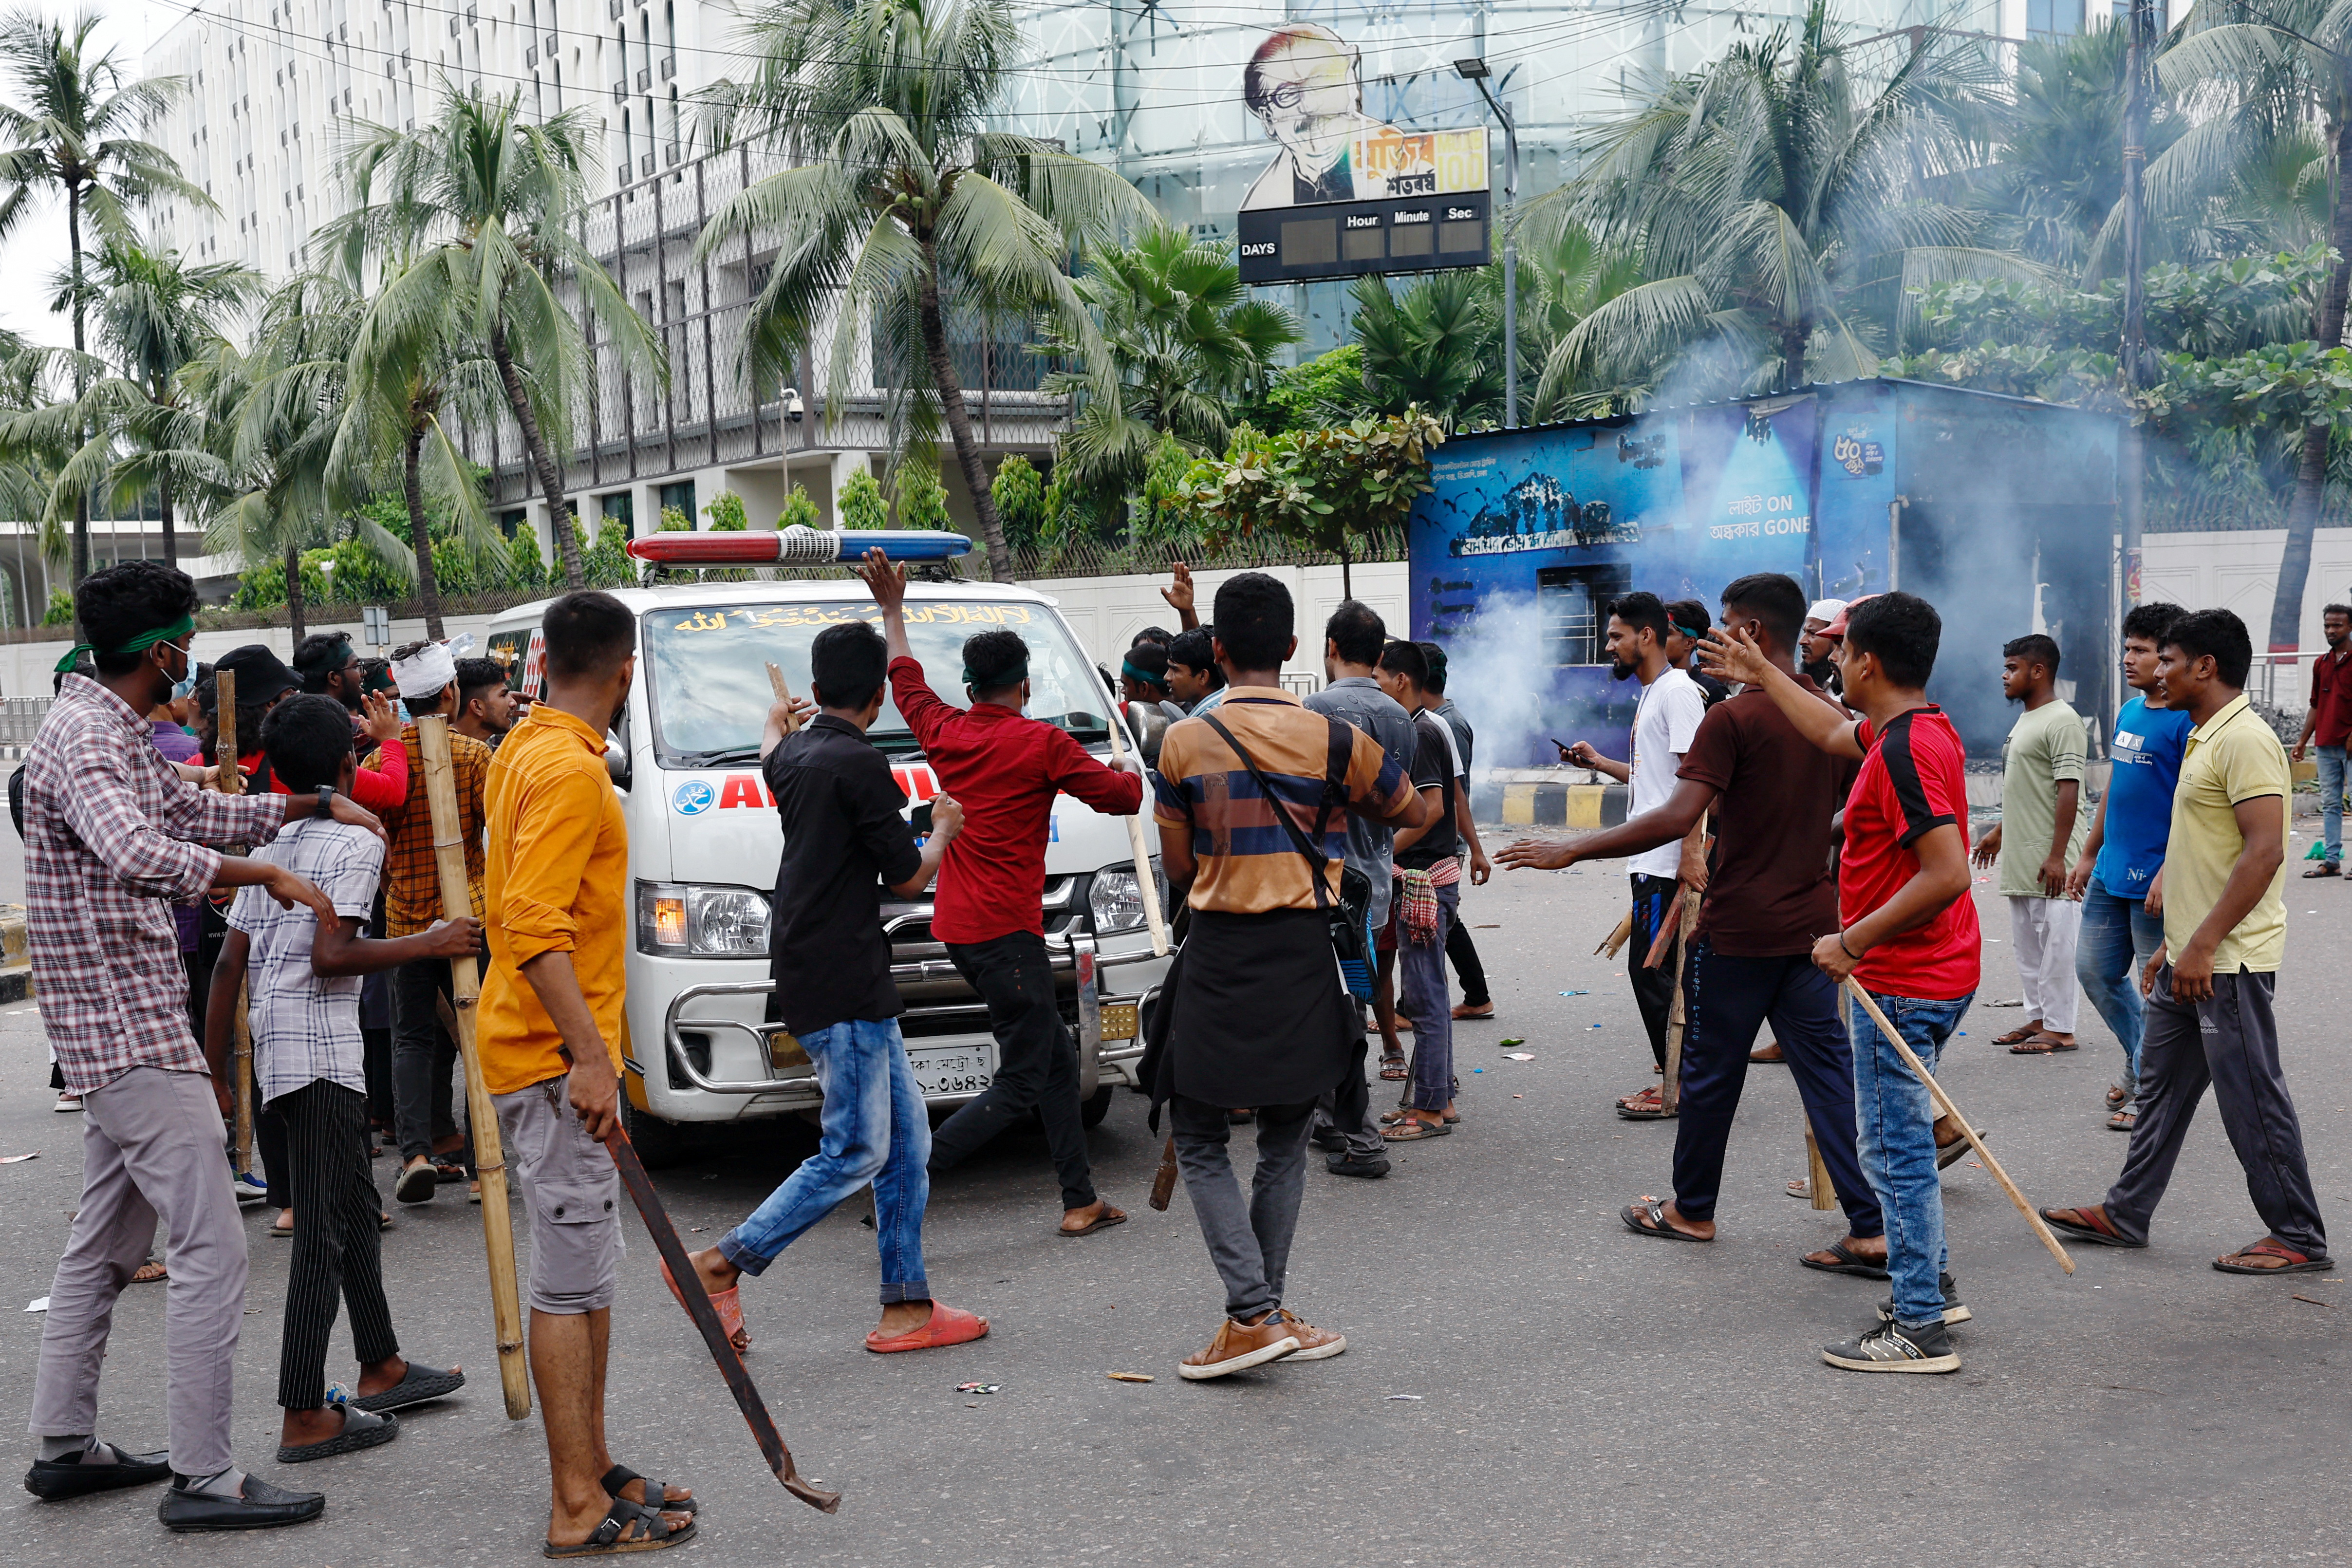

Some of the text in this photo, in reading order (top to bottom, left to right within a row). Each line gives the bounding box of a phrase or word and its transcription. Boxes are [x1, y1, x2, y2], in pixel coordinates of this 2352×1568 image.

[1386, 168, 1435, 195] শতবর্ষ
[1437, 152, 1483, 192] 100
[1347, 206, 1473, 228] Hour Minute Sec
[1242, 242, 1275, 256] DAYS
[1728, 494, 1792, 515] লাইট ON
[1709, 516, 1811, 540] অন্ধকার GONE
[2127, 868, 2147, 881] Ni
[909, 1058, 931, 1071] াকা
[915, 1073, 990, 1094] ১-৩৬৪২
[1905, 1344, 1918, 1356] 1978
